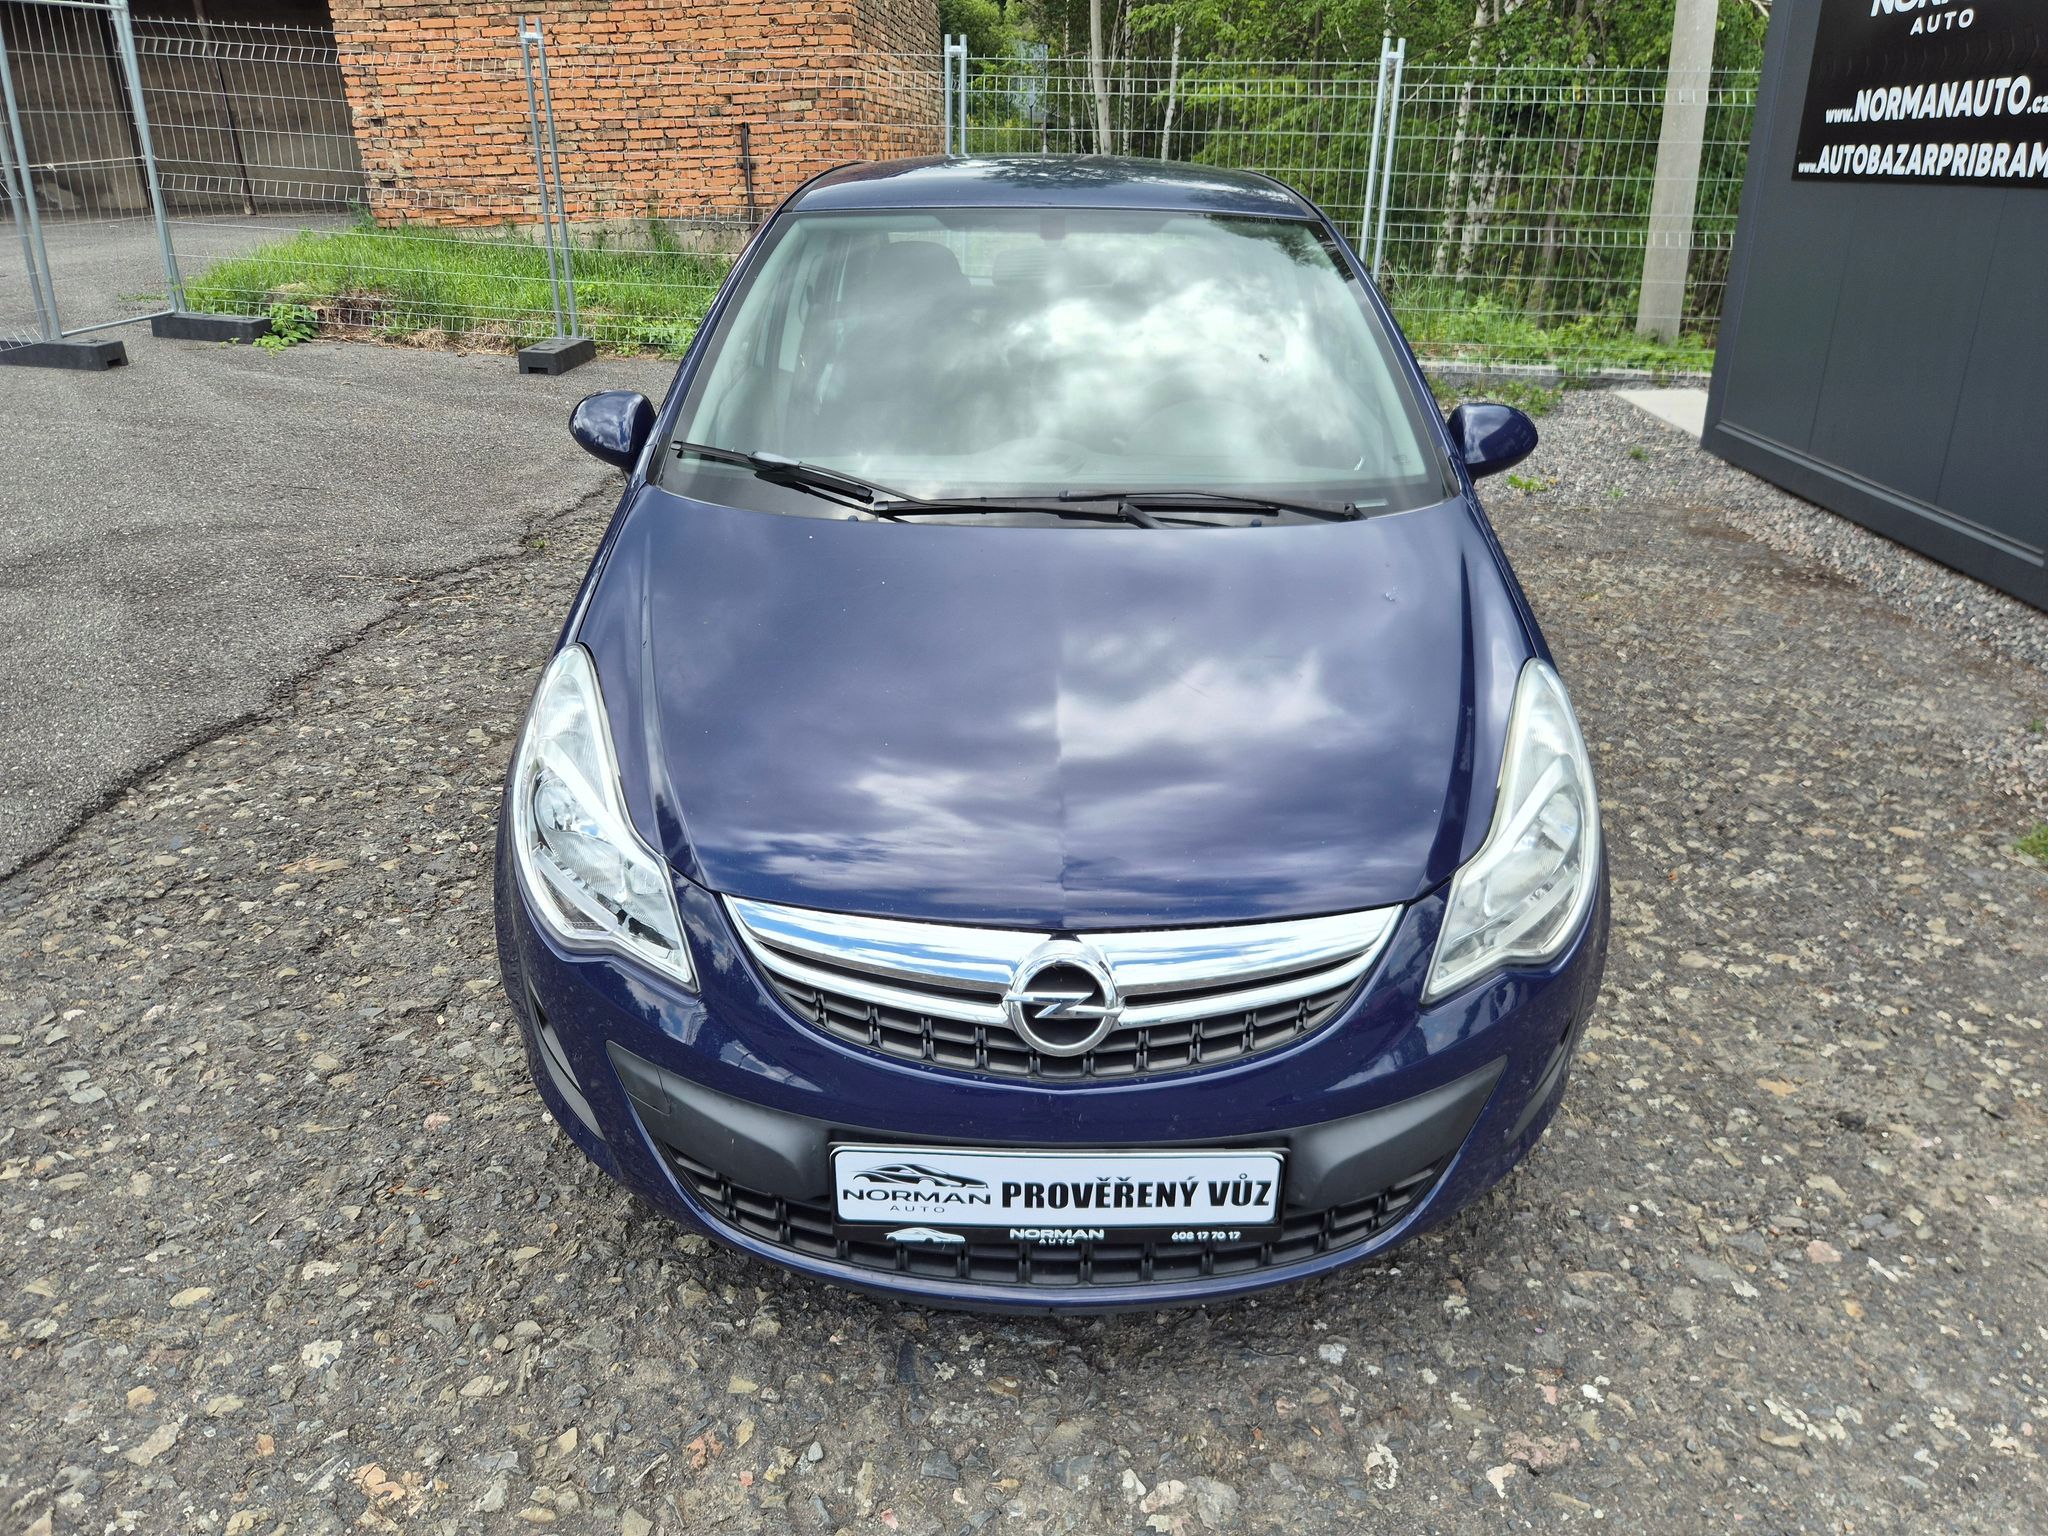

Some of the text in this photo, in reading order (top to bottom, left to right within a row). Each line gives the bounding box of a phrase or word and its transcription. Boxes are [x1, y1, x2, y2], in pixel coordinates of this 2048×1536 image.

[1910, 8, 1975, 36] AUTO
[843, 1189, 991, 1205] NORMAN
[1001, 1173, 1273, 1209] PROVĚŘENÝ VŮZ
[890, 1205, 945, 1213] AUTO
[1009, 1228, 1105, 1240] NORMAN
[1171, 1231, 1241, 1241] 608 17 70 17
